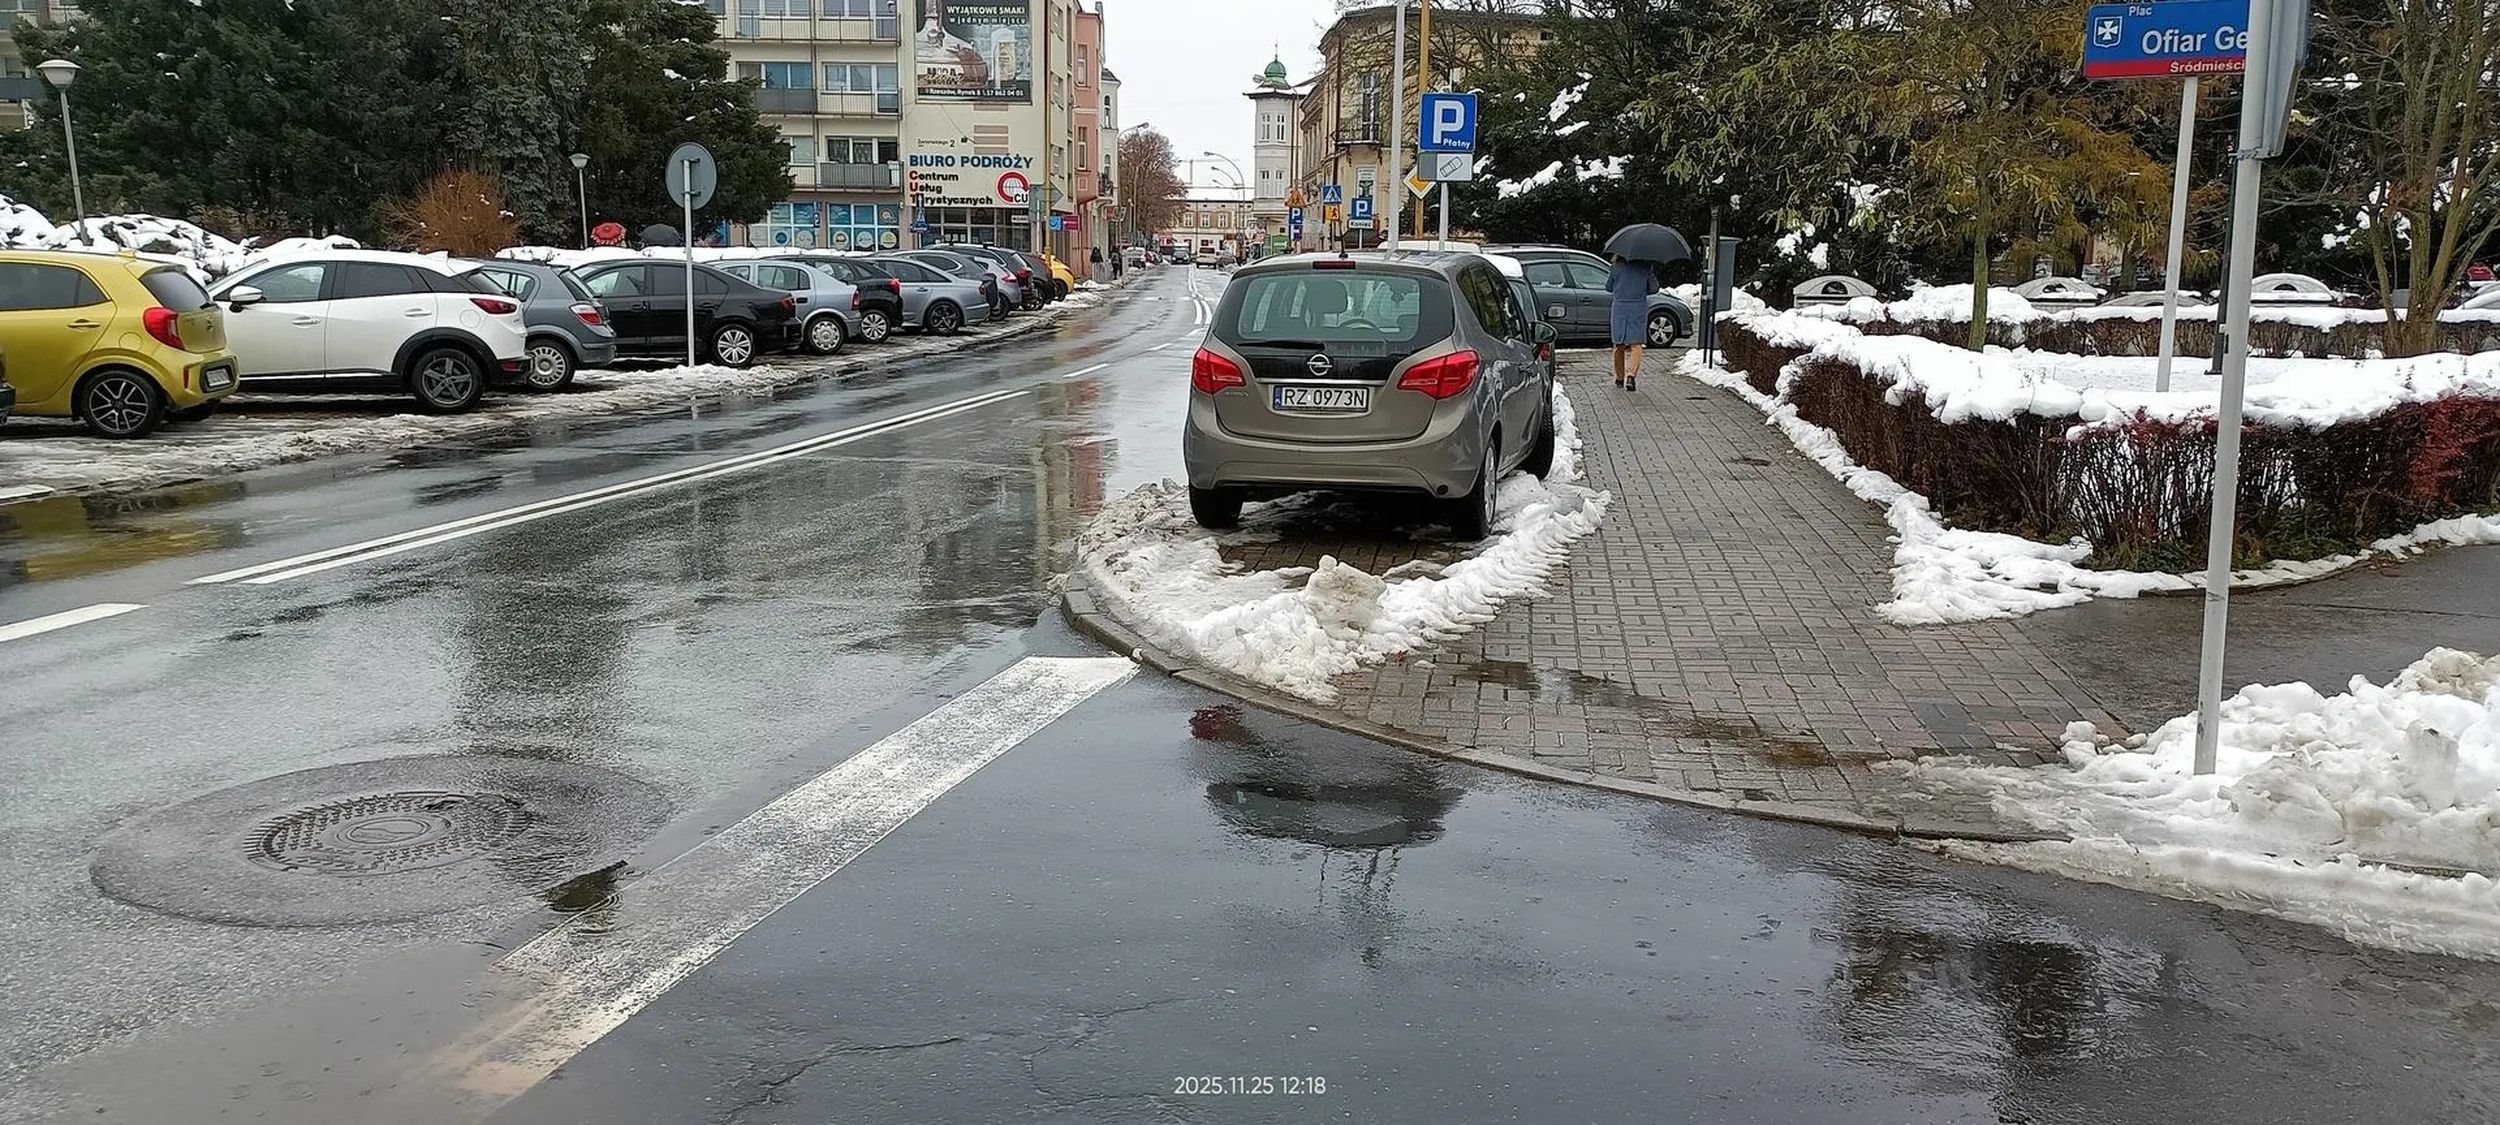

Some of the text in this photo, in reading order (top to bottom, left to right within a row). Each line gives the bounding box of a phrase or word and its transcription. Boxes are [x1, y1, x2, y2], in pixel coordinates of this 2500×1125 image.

[947, 6, 1026, 16] WYJĄTKOWE SMAKI
[2128, 6, 2152, 17] Plac
[2142, 28, 2207, 54] Ofiar
[1433, 100, 1465, 144] P
[1443, 138, 1472, 149] Płatny
[909, 153, 1033, 169] BIURO PODRÓŻY
[909, 170, 959, 181] Centrum
[909, 182, 943, 194] Usług
[909, 194, 993, 205] Trystycznych
[1356, 200, 1368, 217] P
[1284, 389, 1307, 405] RZ
[1313, 389, 1365, 406] 0973N
